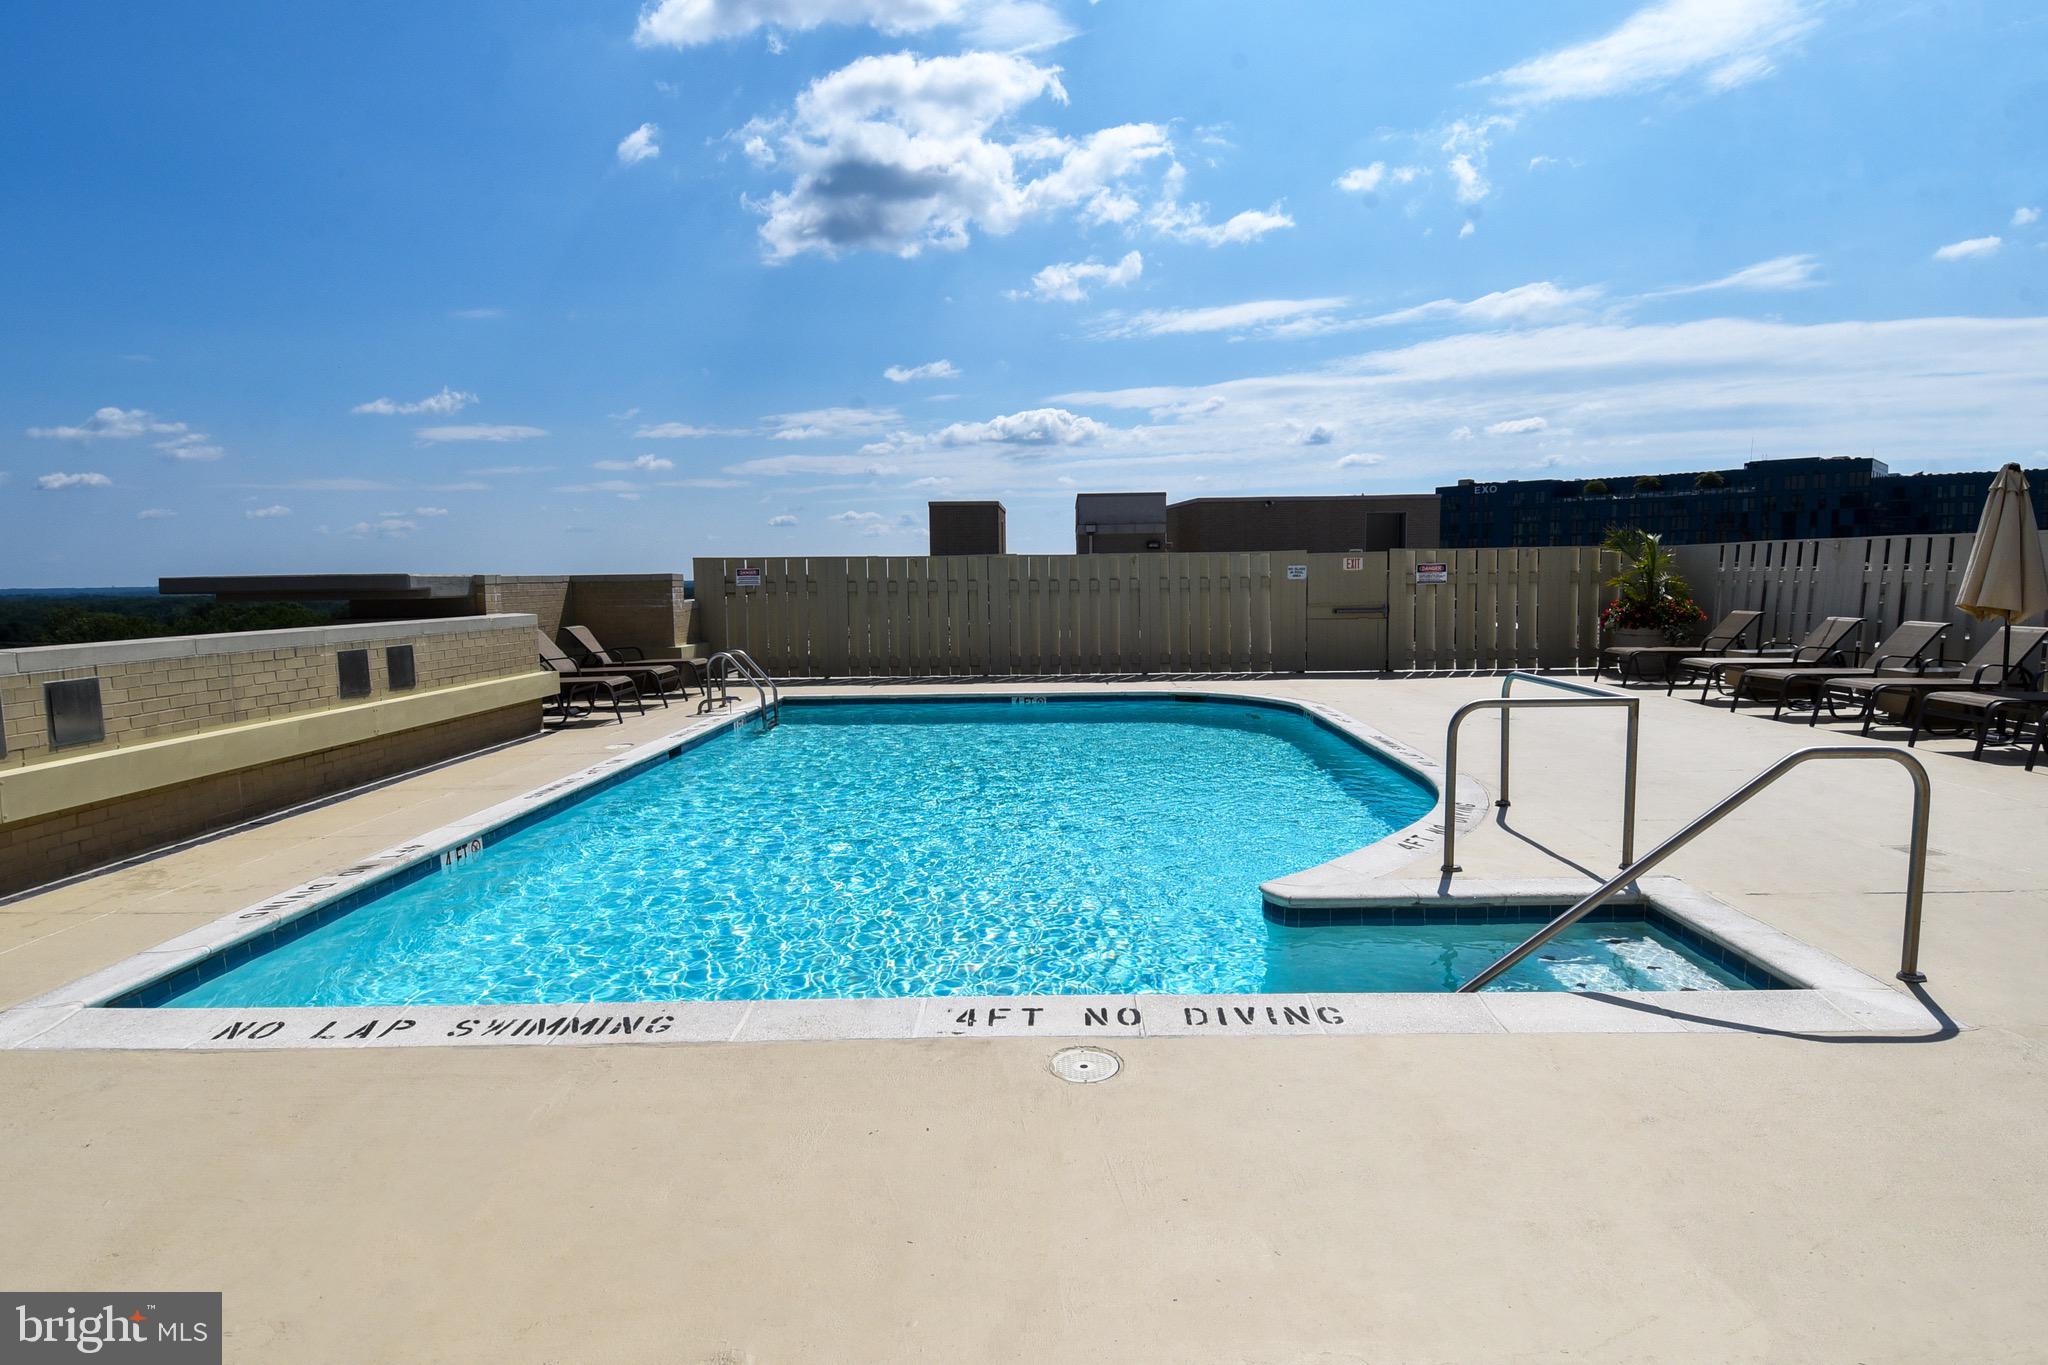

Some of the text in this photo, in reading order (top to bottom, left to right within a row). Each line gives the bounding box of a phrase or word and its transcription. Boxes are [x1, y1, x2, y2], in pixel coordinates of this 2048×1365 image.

[1474, 485, 1498, 495] EXO
[1346, 558, 1361, 570] EXIT
[1420, 564, 1442, 572] DANGER
[238, 882, 338, 919] DIVING
[956, 1005, 1345, 1027] 4FT NO DIVING
[210, 1014, 676, 1041] NO LAP SWIMMING
